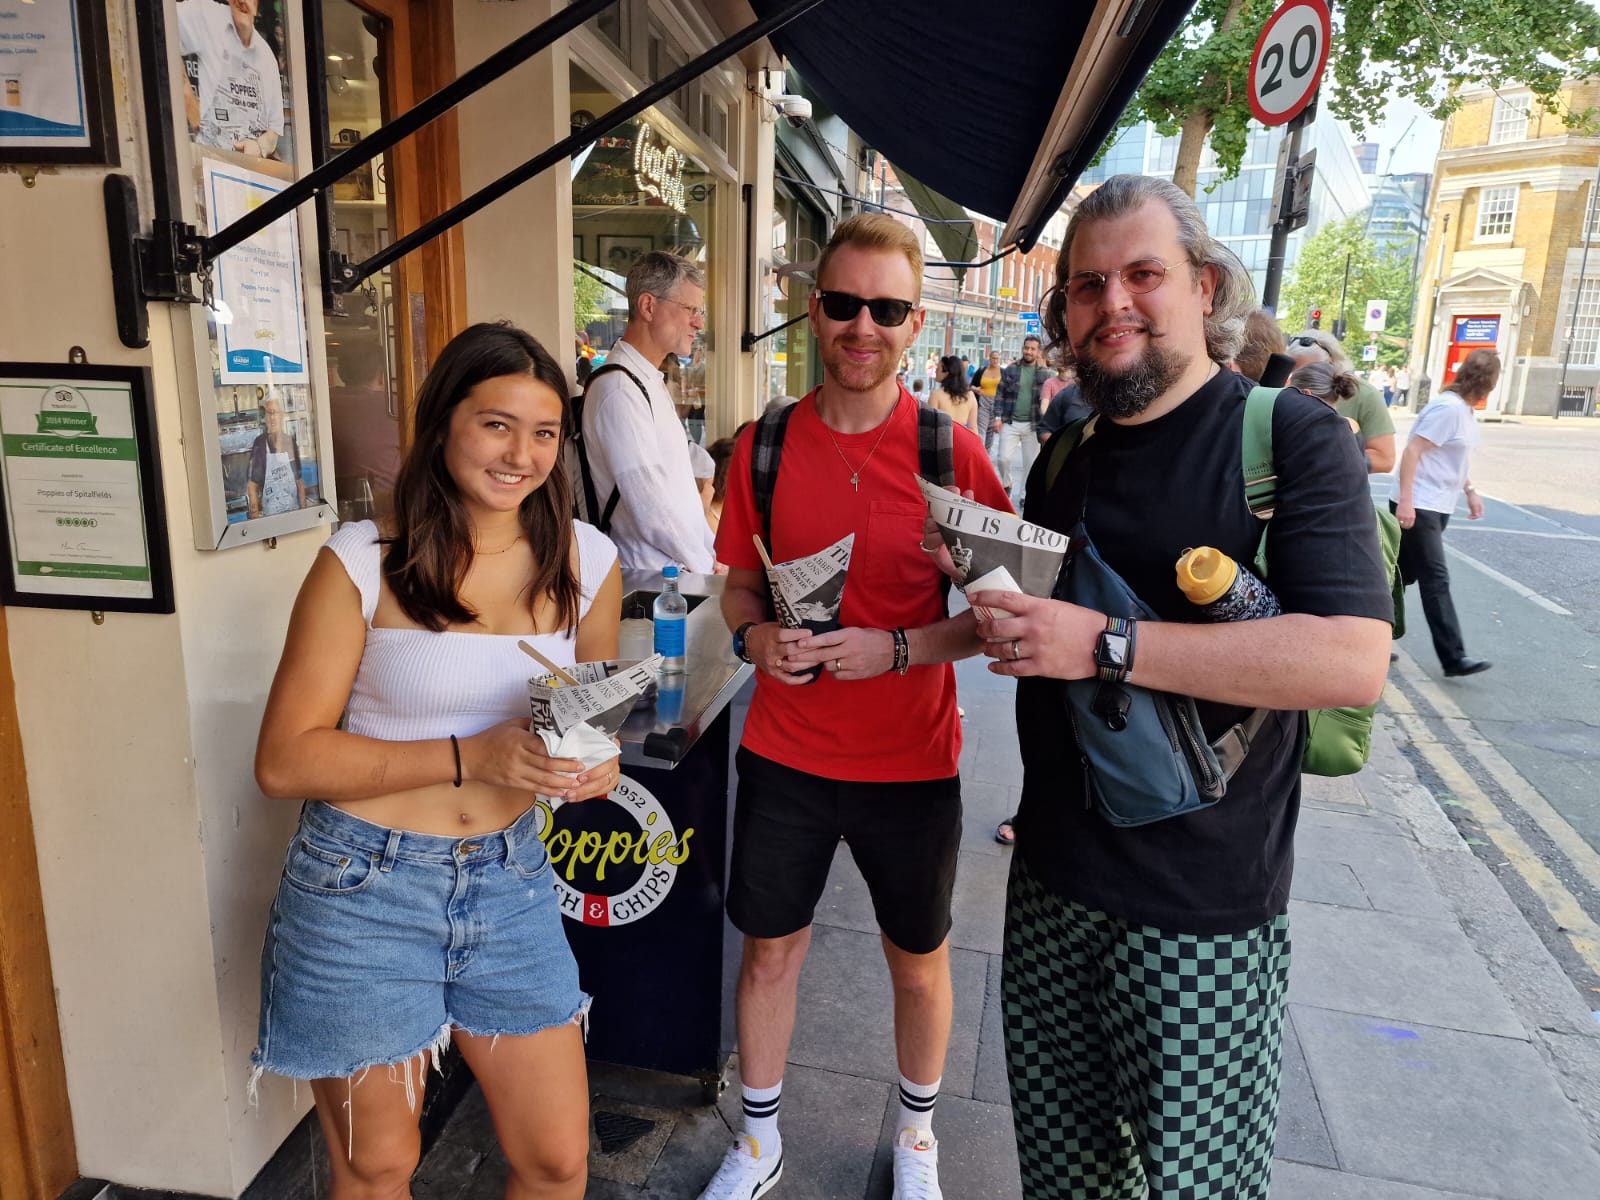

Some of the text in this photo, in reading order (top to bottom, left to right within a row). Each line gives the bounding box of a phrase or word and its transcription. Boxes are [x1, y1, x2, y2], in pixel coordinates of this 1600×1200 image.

[1260, 24, 1317, 98] 20
[230, 82, 257, 98] POPPIES
[63, 417, 87, 425] Winner
[22, 442, 118, 454] Certificate of Excellence
[37, 489, 65, 498] Poppies
[74, 490, 112, 499] Spitalfields
[980, 516, 1001, 535] IS
[588, 902, 605, 919] &
[612, 866, 670, 921] CHIPS
